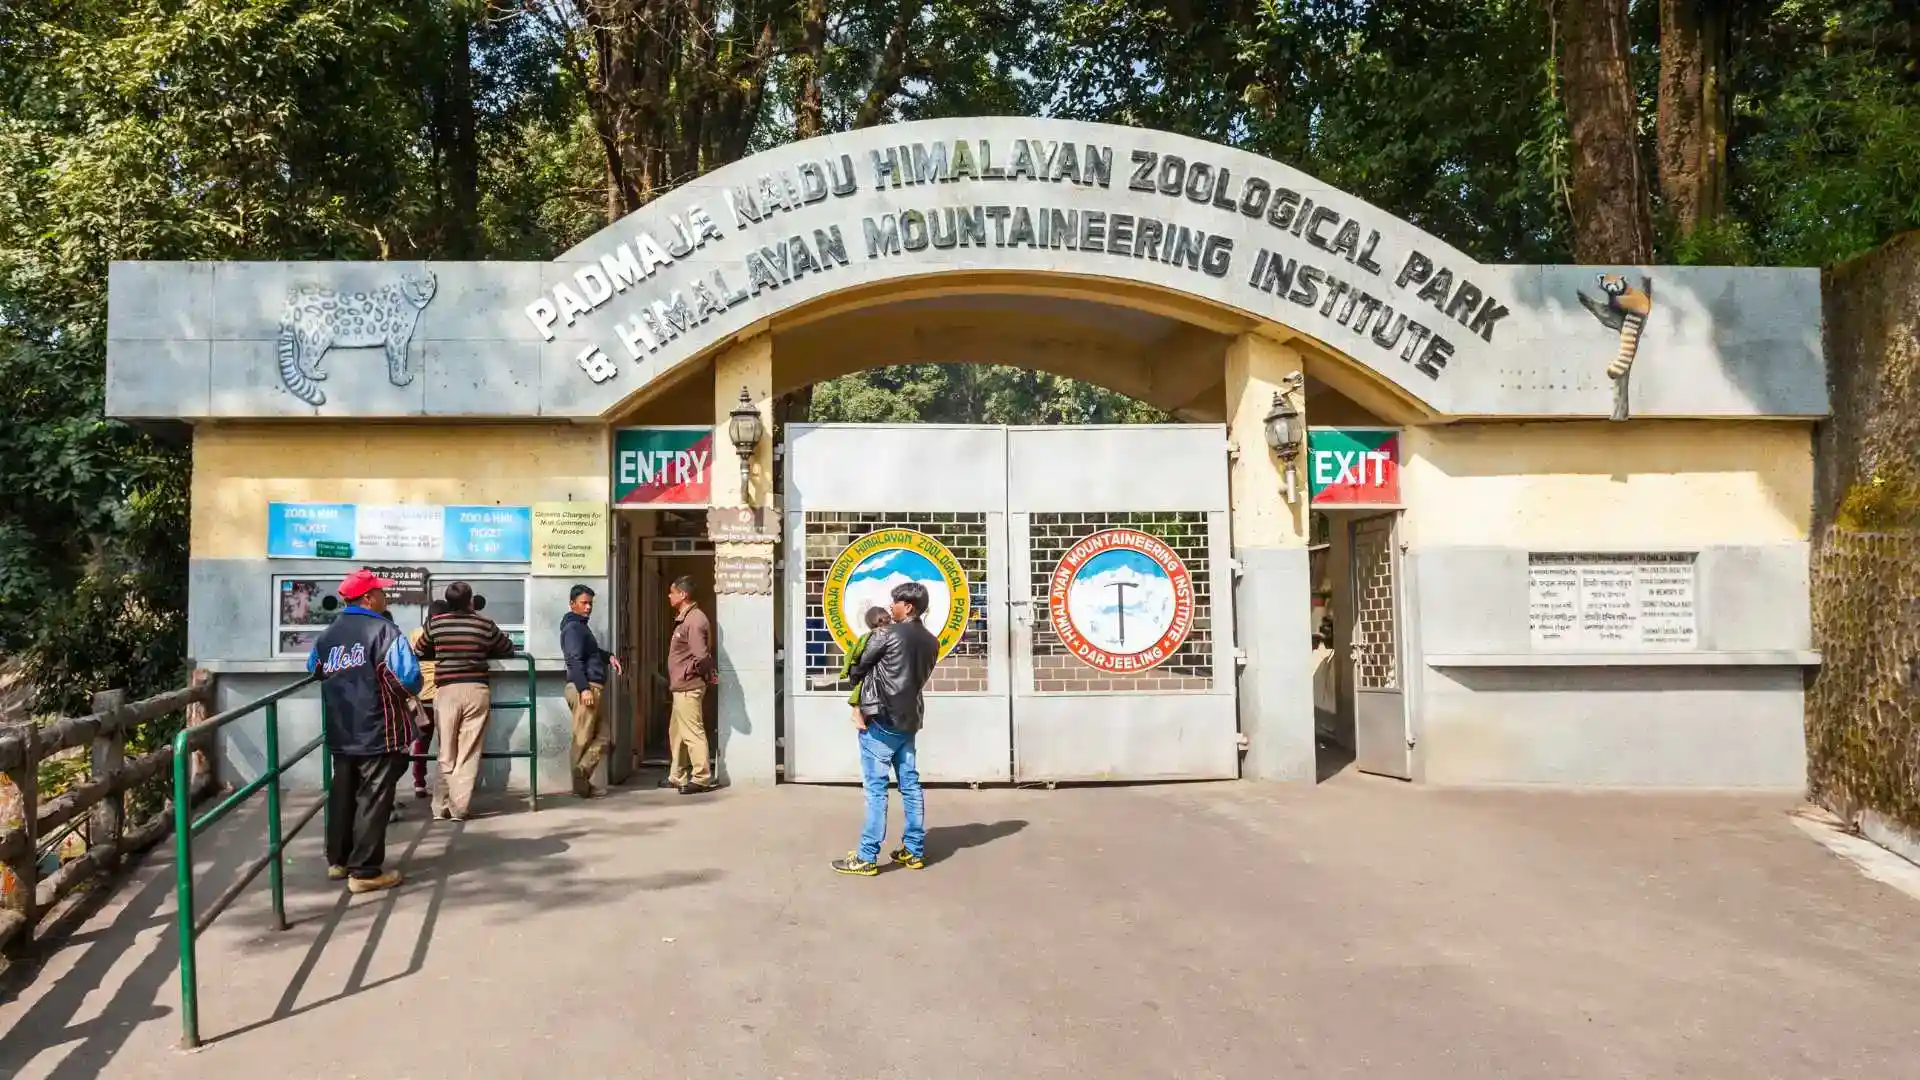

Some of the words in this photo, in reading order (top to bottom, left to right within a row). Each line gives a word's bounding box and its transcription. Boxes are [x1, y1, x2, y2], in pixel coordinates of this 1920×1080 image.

[525, 206, 724, 343] PADMAJA
[722, 154, 858, 231] NAIDU
[870, 138, 1112, 190] HIMALAYAN
[1129, 149, 1382, 276] ZOOLOGICAL
[1395, 250, 1509, 343] PARK
[614, 224, 850, 364] HIMALAYAN
[862, 205, 1233, 278] MOUNTAINEERING
[1248, 246, 1455, 381] INSTITUTE
[620, 450, 709, 484] ENTRY
[1315, 450, 1390, 484] EXIT
[562, 511, 590, 519] Charges
[855, 533, 913, 556] HIMALAYAN
[832, 554, 854, 582] NAIDU
[917, 536, 963, 592] ZOOLOGICAL
[1053, 566, 1077, 643] HIMALAYAN
[1067, 532, 1179, 571] MOUNTAINEERING
[1168, 575, 1190, 642] INSTITUTE
[828, 587, 846, 637] PADMAJA
[949, 598, 965, 632] PARK
[323, 643, 366, 672] Mets
[1079, 646, 1164, 669] DARJEELING
